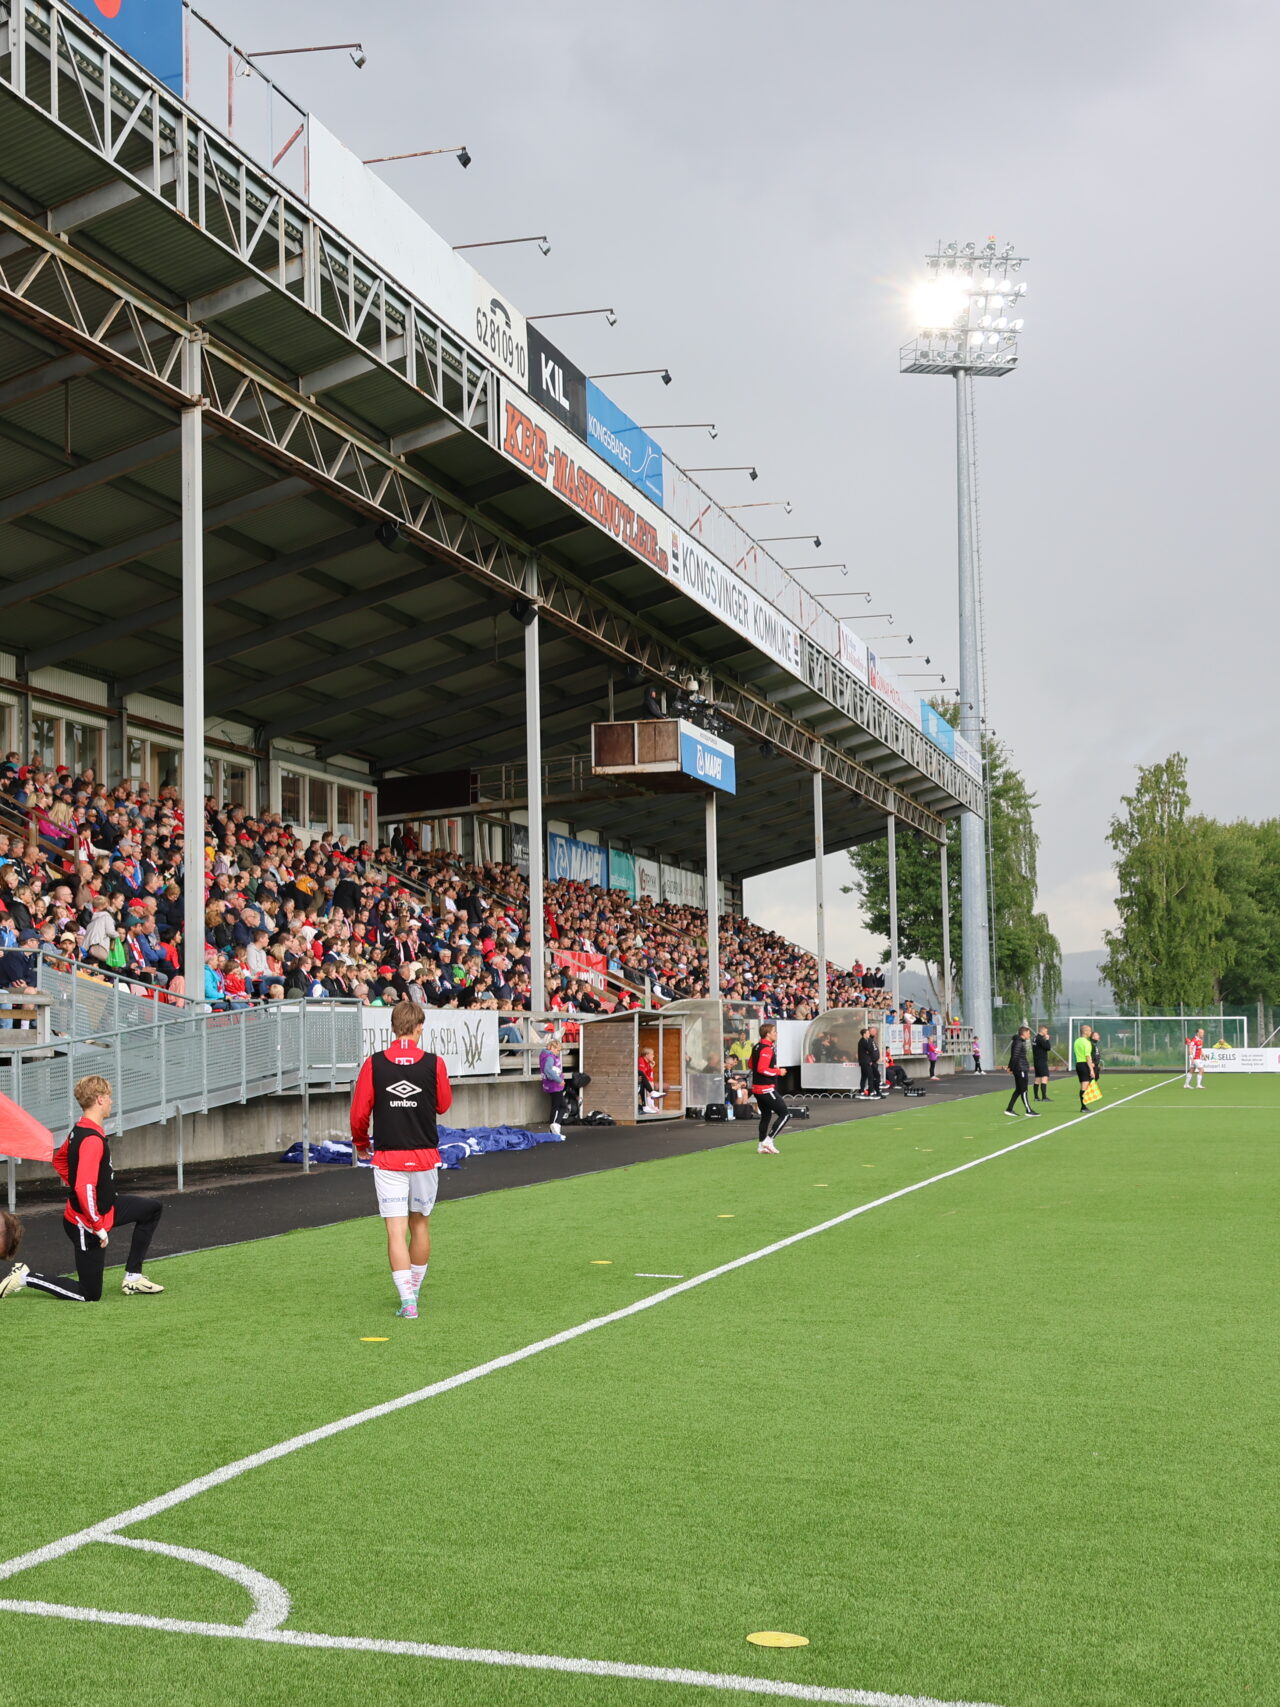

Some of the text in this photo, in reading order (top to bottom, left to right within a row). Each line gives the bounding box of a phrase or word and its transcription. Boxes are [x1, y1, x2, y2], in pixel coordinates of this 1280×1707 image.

[540, 352, 570, 411] KIL
[588, 412, 632, 467] KONGSBADET
[681, 543, 750, 630] KONGSVINGER
[753, 601, 792, 663] KOMMUNE
[440, 1027, 458, 1055] SPA
[389, 1099, 418, 1108] umbro
